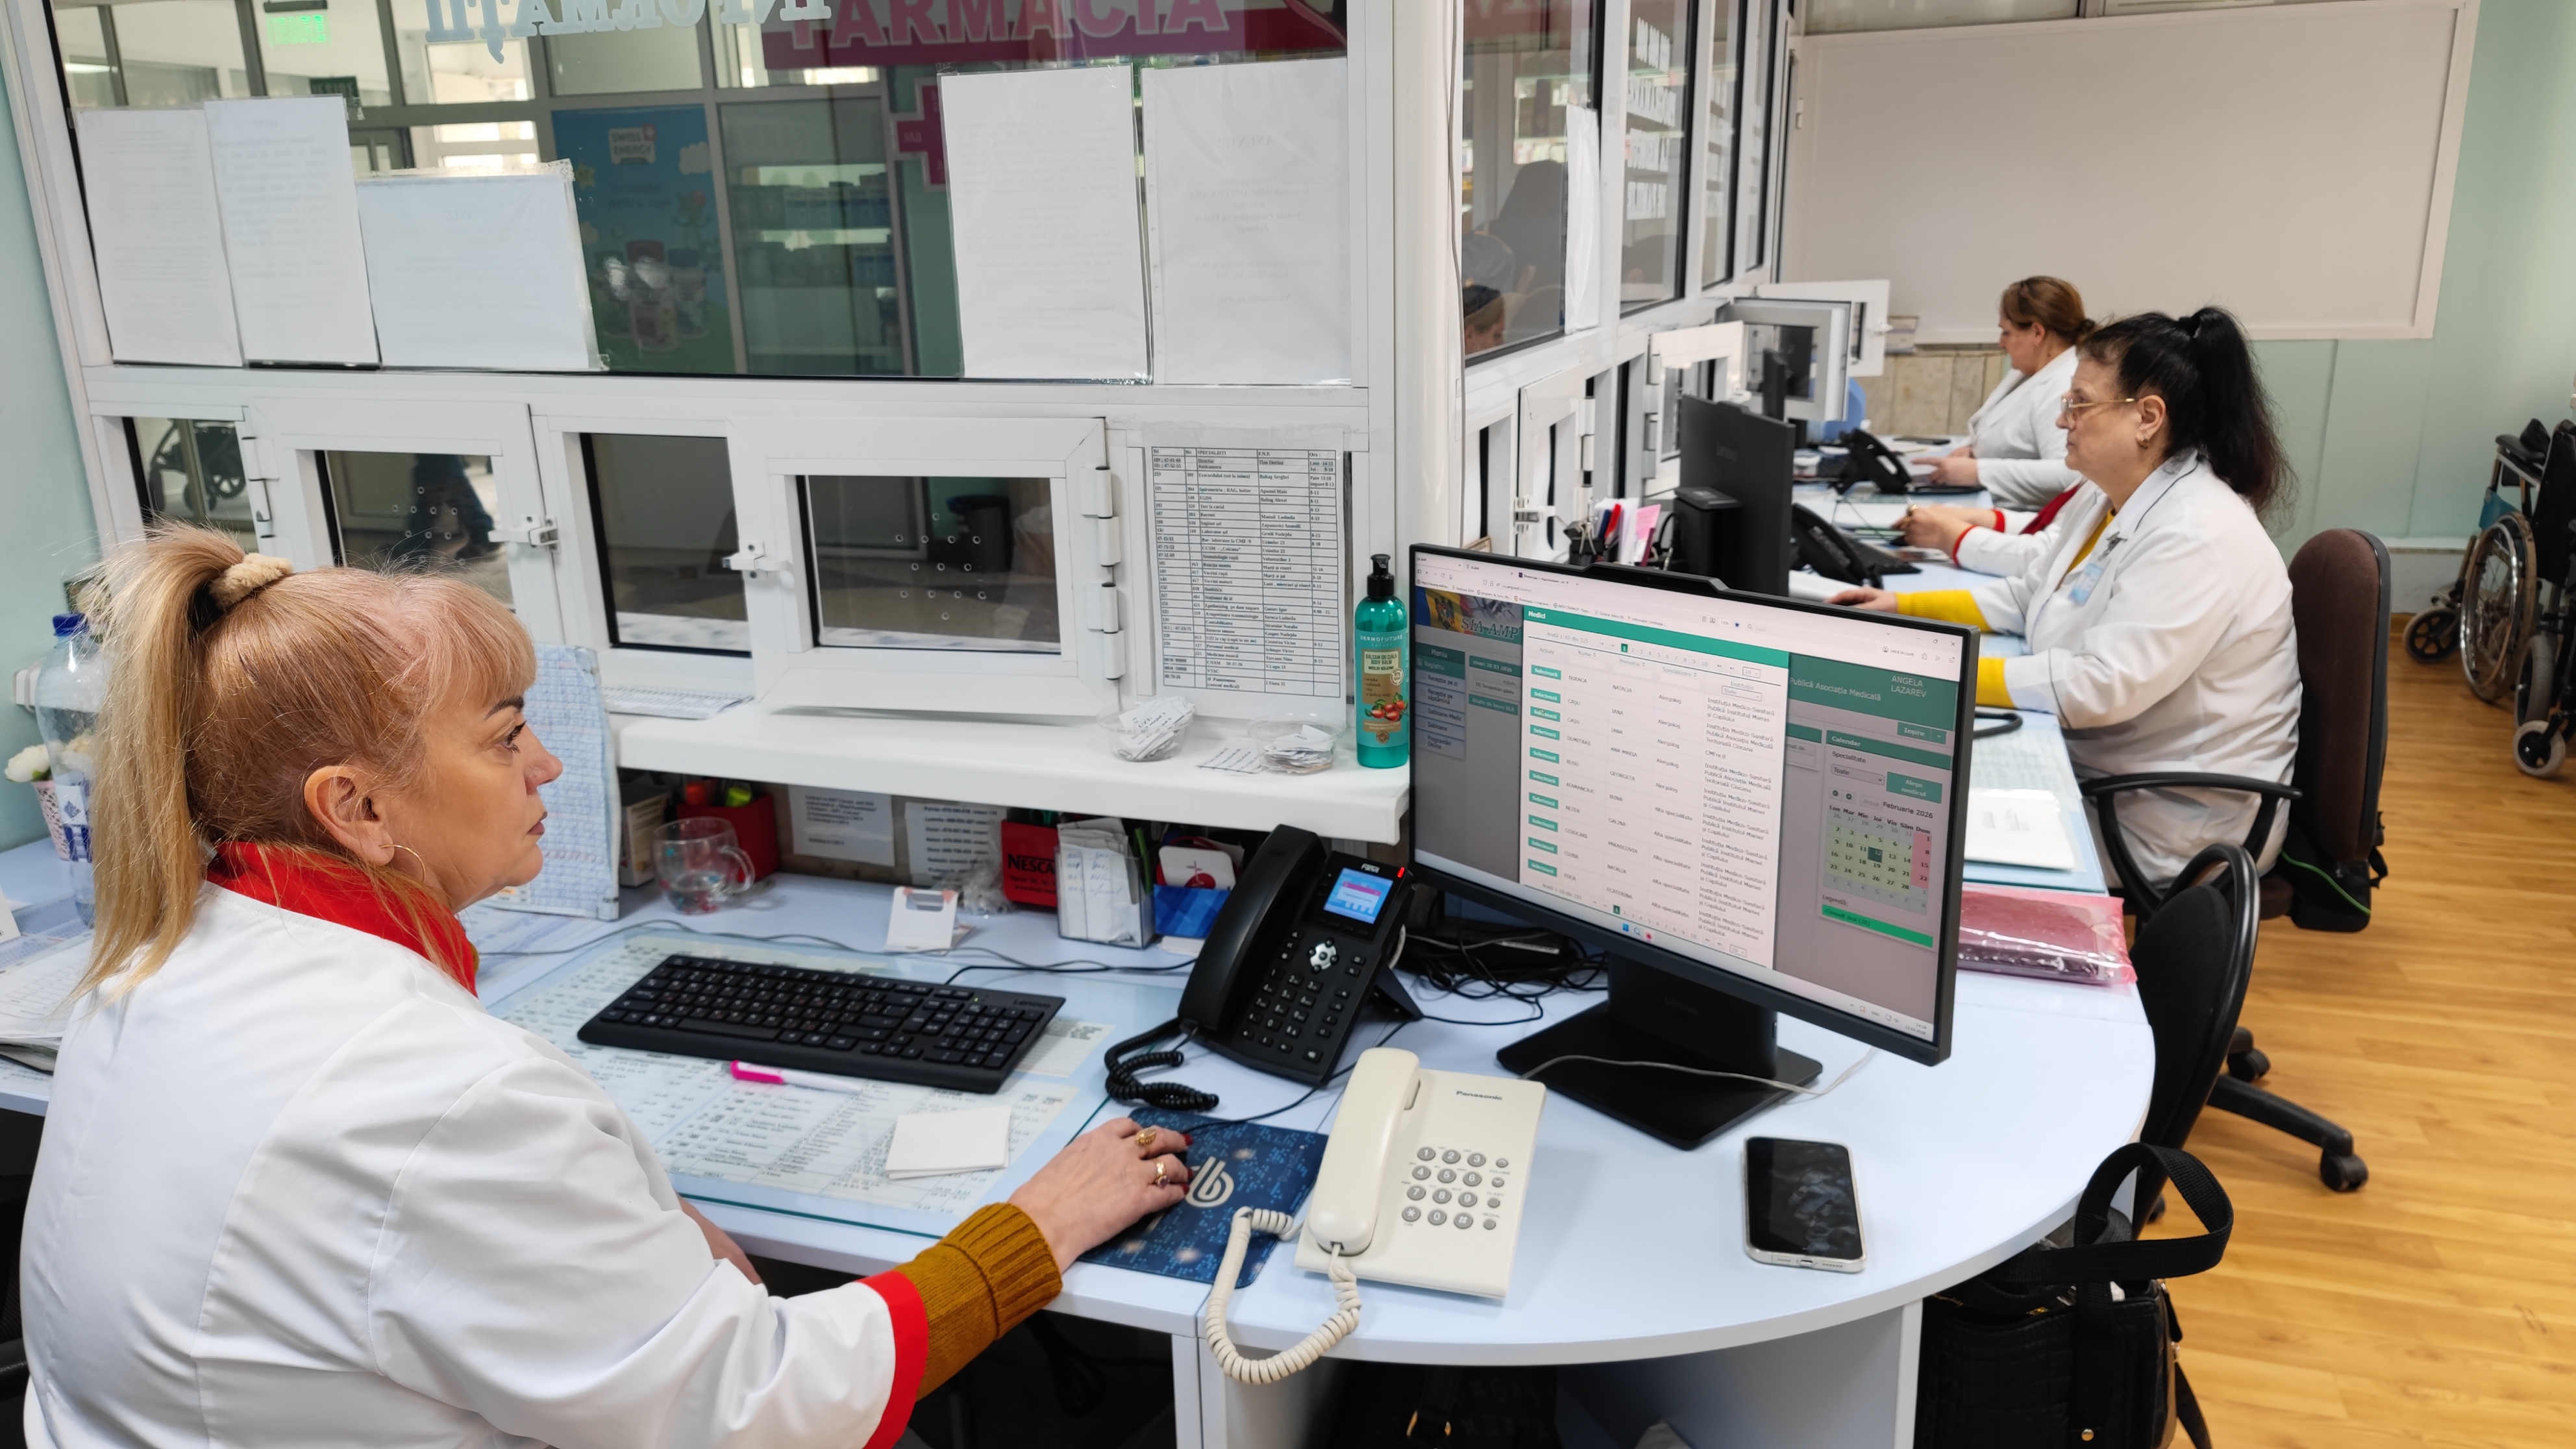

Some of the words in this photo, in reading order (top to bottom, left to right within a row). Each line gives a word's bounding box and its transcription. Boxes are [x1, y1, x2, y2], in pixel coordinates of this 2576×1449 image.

[793, 0, 1231, 49] ARMACIA
[1528, 611, 1546, 619] Medici
[1461, 616, 1483, 633] SIA
[1487, 623, 1519, 639] AMP
[1431, 649, 1448, 658] Meniu
[1891, 675, 1923, 687] ANGELA
[1815, 682, 1848, 695] Asociația
[1850, 688, 1881, 701] Medicală
[1891, 685, 1927, 698] LAZAREV
[1707, 697, 1731, 708] Instituția
[1732, 702, 1775, 716] Medico-Sanitară
[1707, 704, 1725, 713] Publică
[1727, 709, 1750, 719] Institutul
[1752, 714, 1770, 723] Mamei
[1713, 713, 1735, 722] Copilului
[1706, 723, 1729, 733] Instituția
[1731, 728, 1774, 742] Medico-Sanitară
[1903, 727, 1925, 737] Ieșire
[1706, 730, 1724, 738] Publică
[1726, 734, 1749, 745] Asociația
[1750, 739, 1774, 750] Medicală
[1706, 737, 1731, 747] Teritorială
[1733, 743, 1753, 752] Ciocana
[1831, 736, 1861, 747] Calendar
[1832, 751, 1866, 763] Specialitate
[1705, 762, 1728, 773] Instituția
[1729, 768, 1772, 783] Medico-Sanitară
[1833, 767, 1850, 775] Toate
[1704, 770, 1722, 778] Publică
[1724, 774, 1746, 785] Asociația
[1748, 779, 1771, 791] Medicală
[1905, 779, 1923, 789] Alege
[1731, 784, 1751, 793] Ciocana
[1901, 786, 1926, 797] medicul
[1883, 801, 1914, 814] Februarie
[1916, 809, 1933, 819] 2026
[1456, 1090, 1503, 1100] Panasonic
[1439, 1191, 1445, 1199] 8
[1433, 1213, 1441, 1221] 0
